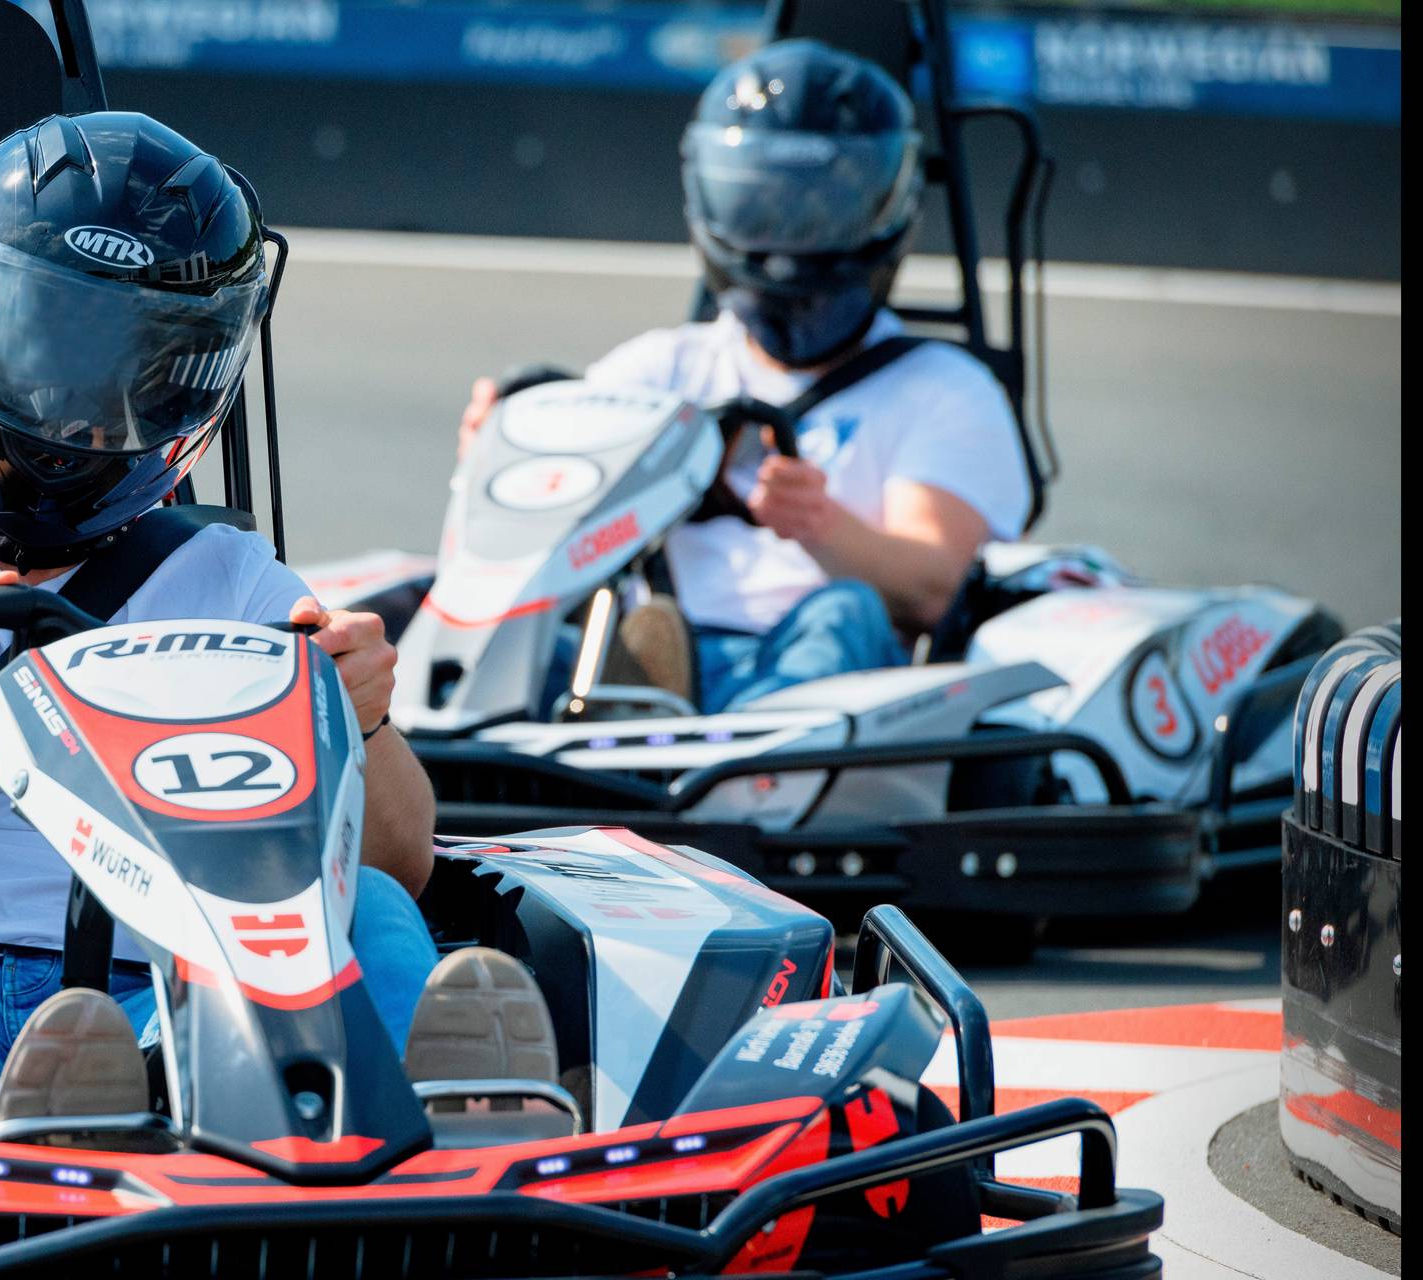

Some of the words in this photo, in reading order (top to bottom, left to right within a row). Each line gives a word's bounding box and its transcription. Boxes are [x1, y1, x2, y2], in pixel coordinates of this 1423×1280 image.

[75, 231, 148, 266] MTR
[1146, 673, 1177, 738] 3
[151, 750, 282, 795] 12
[92, 836, 153, 897] WÜRTH
